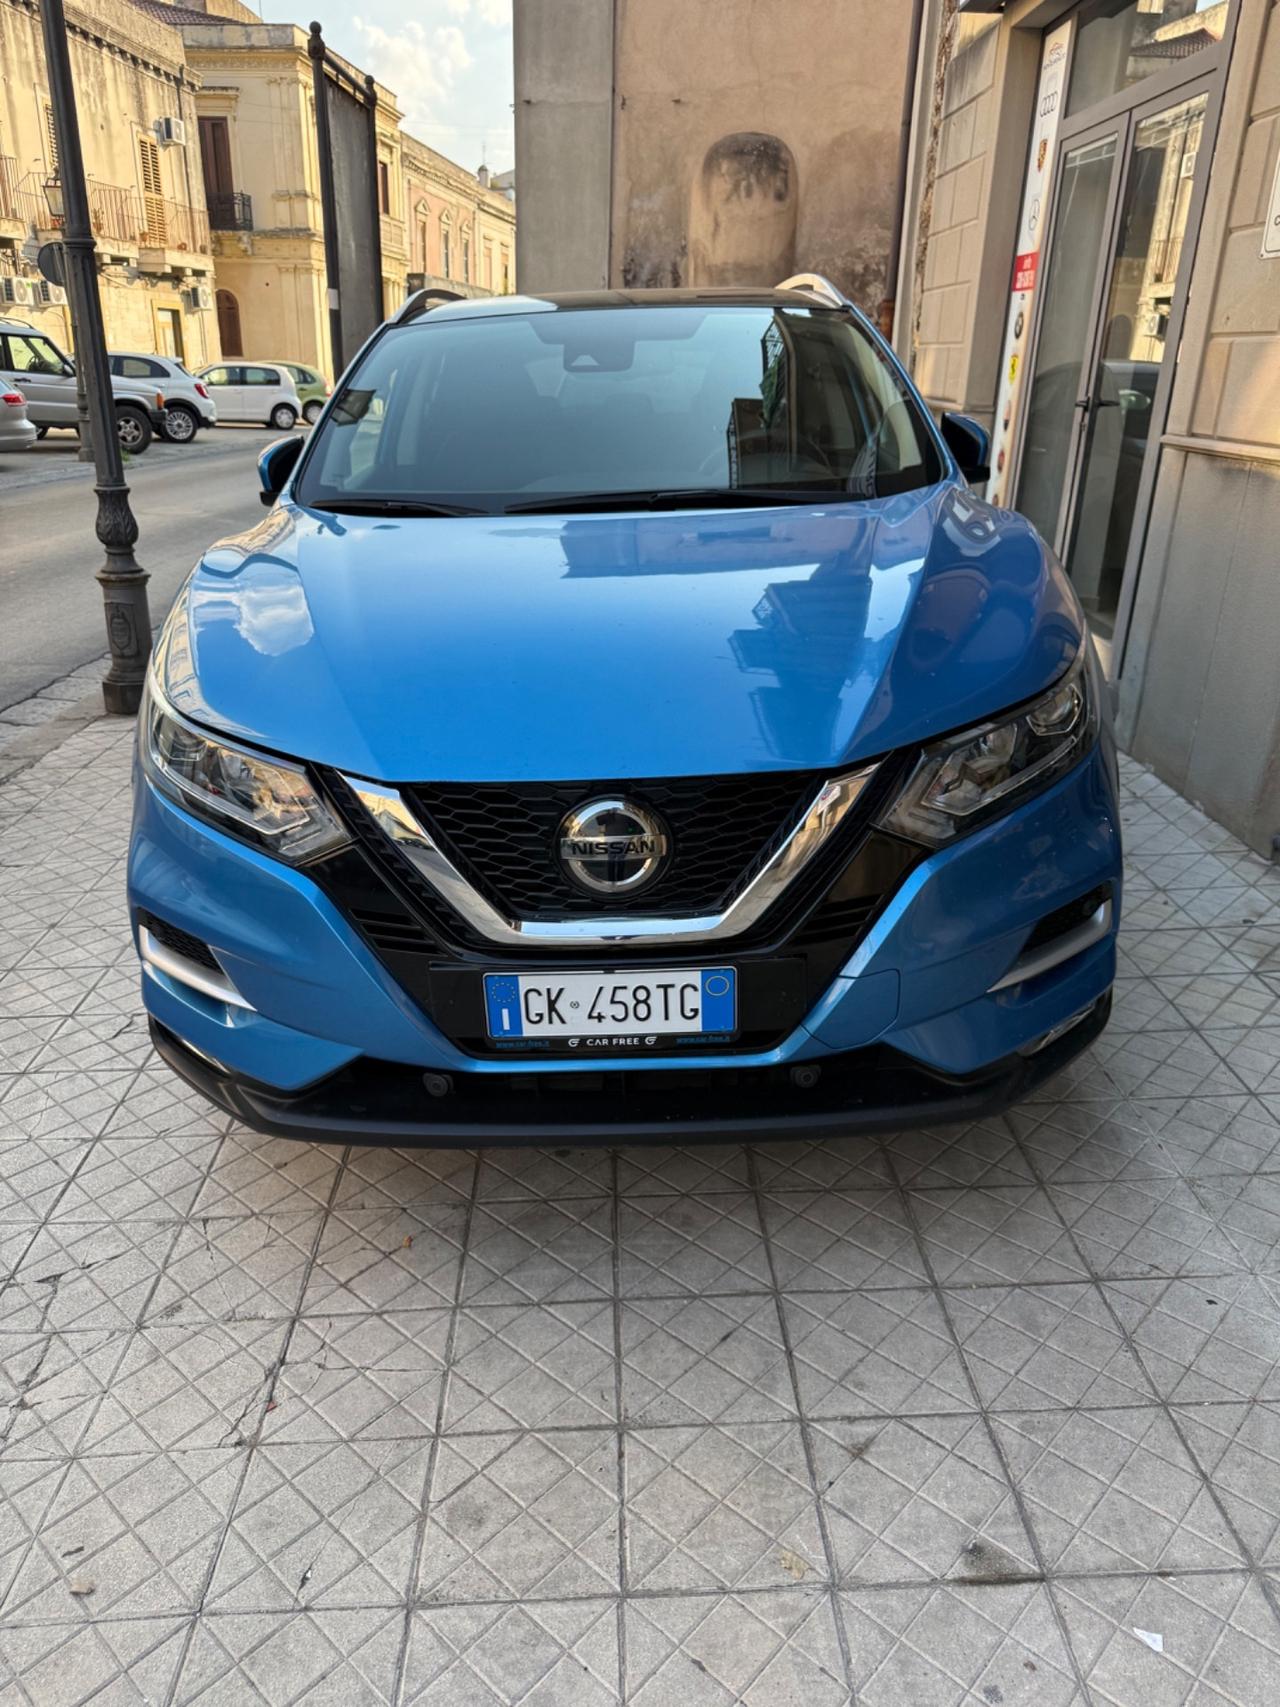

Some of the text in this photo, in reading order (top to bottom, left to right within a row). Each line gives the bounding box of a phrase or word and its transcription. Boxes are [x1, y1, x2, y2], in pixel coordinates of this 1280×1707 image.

[571, 840, 655, 855] NISSAN
[524, 983, 700, 1025] GK 458TG
[586, 1037, 640, 1046] CAR FREE
